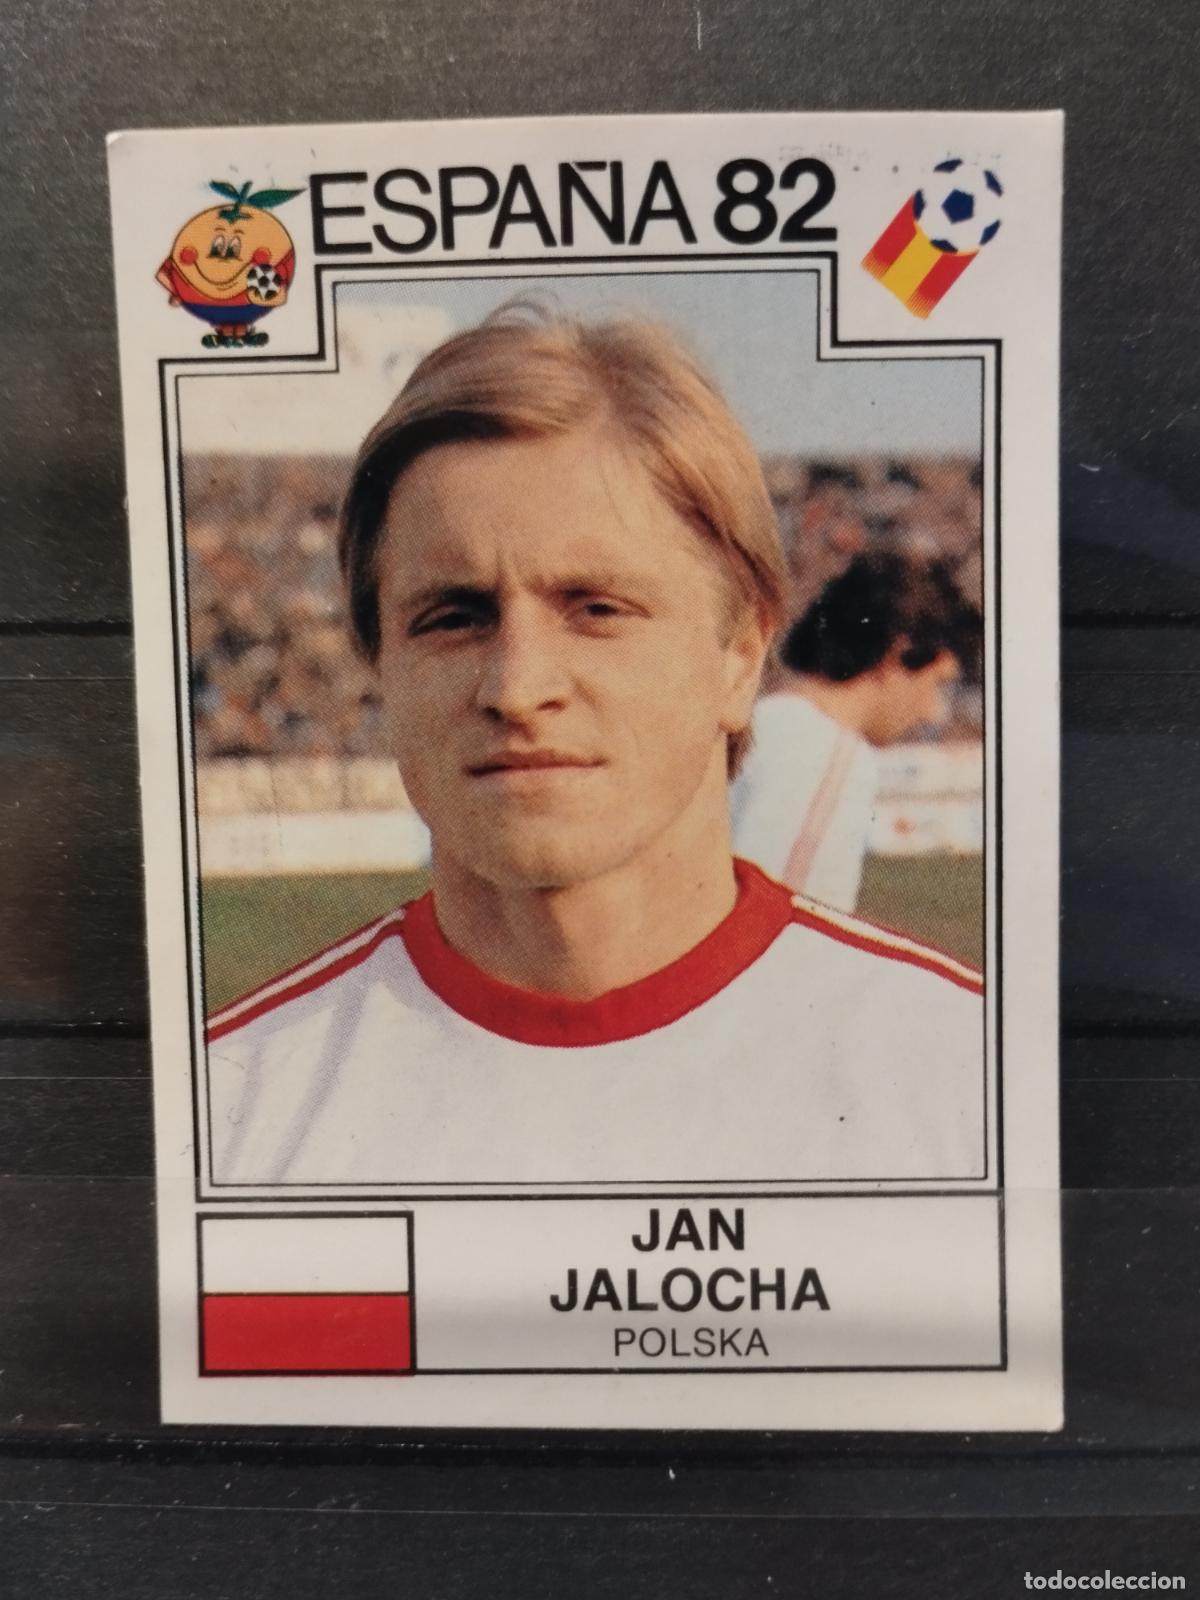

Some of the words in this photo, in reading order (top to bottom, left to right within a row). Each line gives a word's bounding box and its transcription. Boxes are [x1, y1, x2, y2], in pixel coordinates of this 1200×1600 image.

[309, 159, 697, 256] ESPAÑA
[713, 157, 838, 245] 82
[631, 1208, 745, 1252] JAN
[550, 1267, 831, 1312] JALOCHA
[614, 1327, 769, 1357] POLSKA
